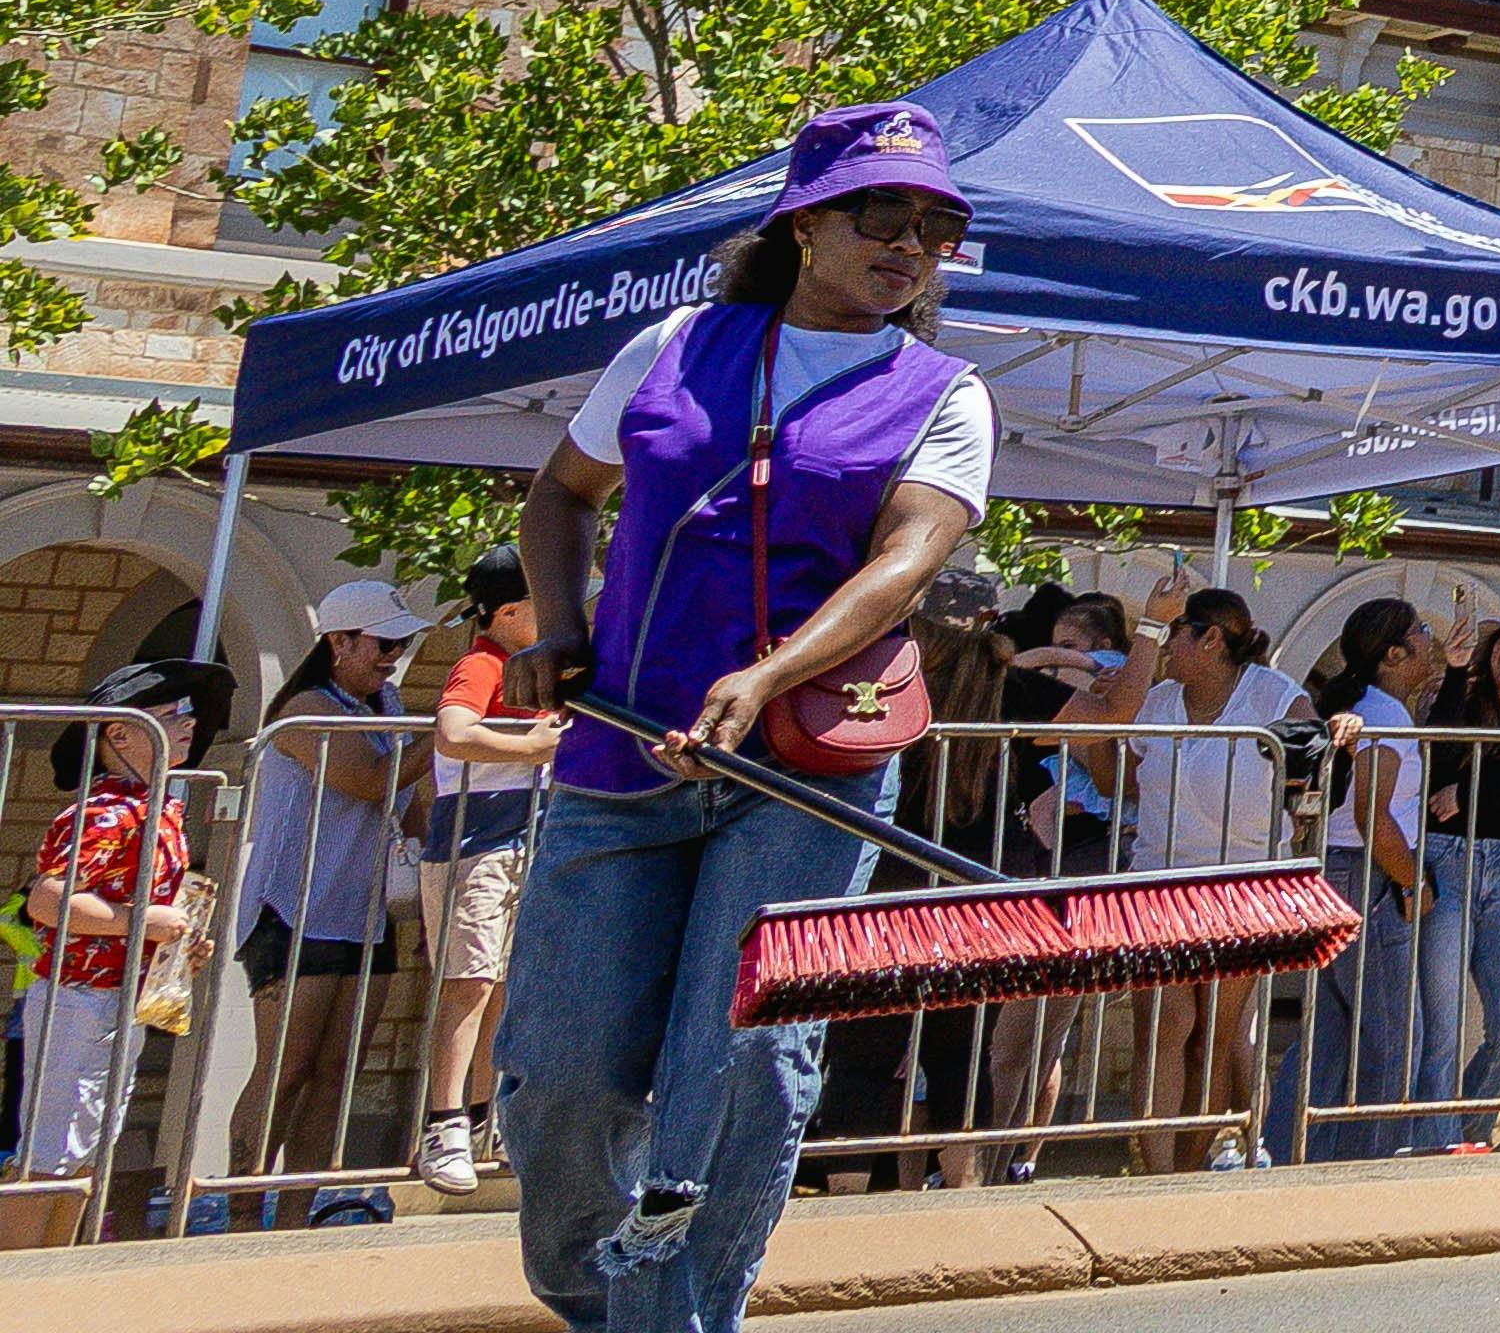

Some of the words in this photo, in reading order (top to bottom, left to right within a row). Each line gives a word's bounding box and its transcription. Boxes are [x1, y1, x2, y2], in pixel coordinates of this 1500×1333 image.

[337, 335, 398, 387] City
[399, 317, 435, 369] of
[434, 254, 722, 360] Kalgoorlie-Boulde
